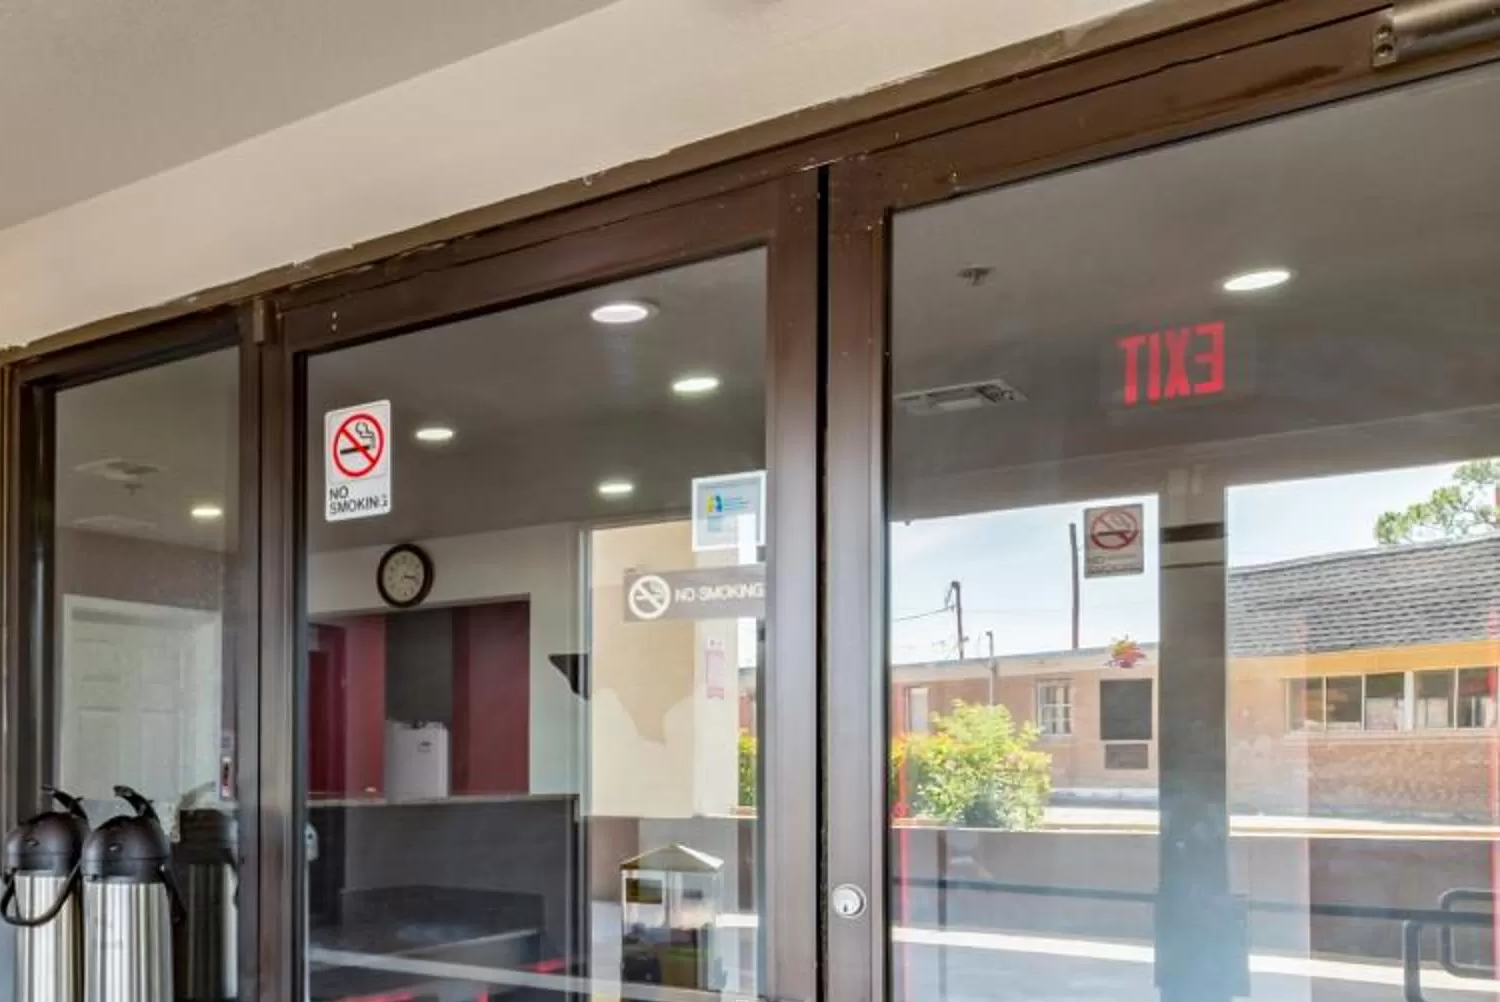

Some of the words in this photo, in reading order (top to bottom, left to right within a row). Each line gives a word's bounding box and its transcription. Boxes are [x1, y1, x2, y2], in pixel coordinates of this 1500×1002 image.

[329, 485, 349, 500] NO
[674, 587, 695, 603] NO
[699, 582, 765, 602] SMOKING
